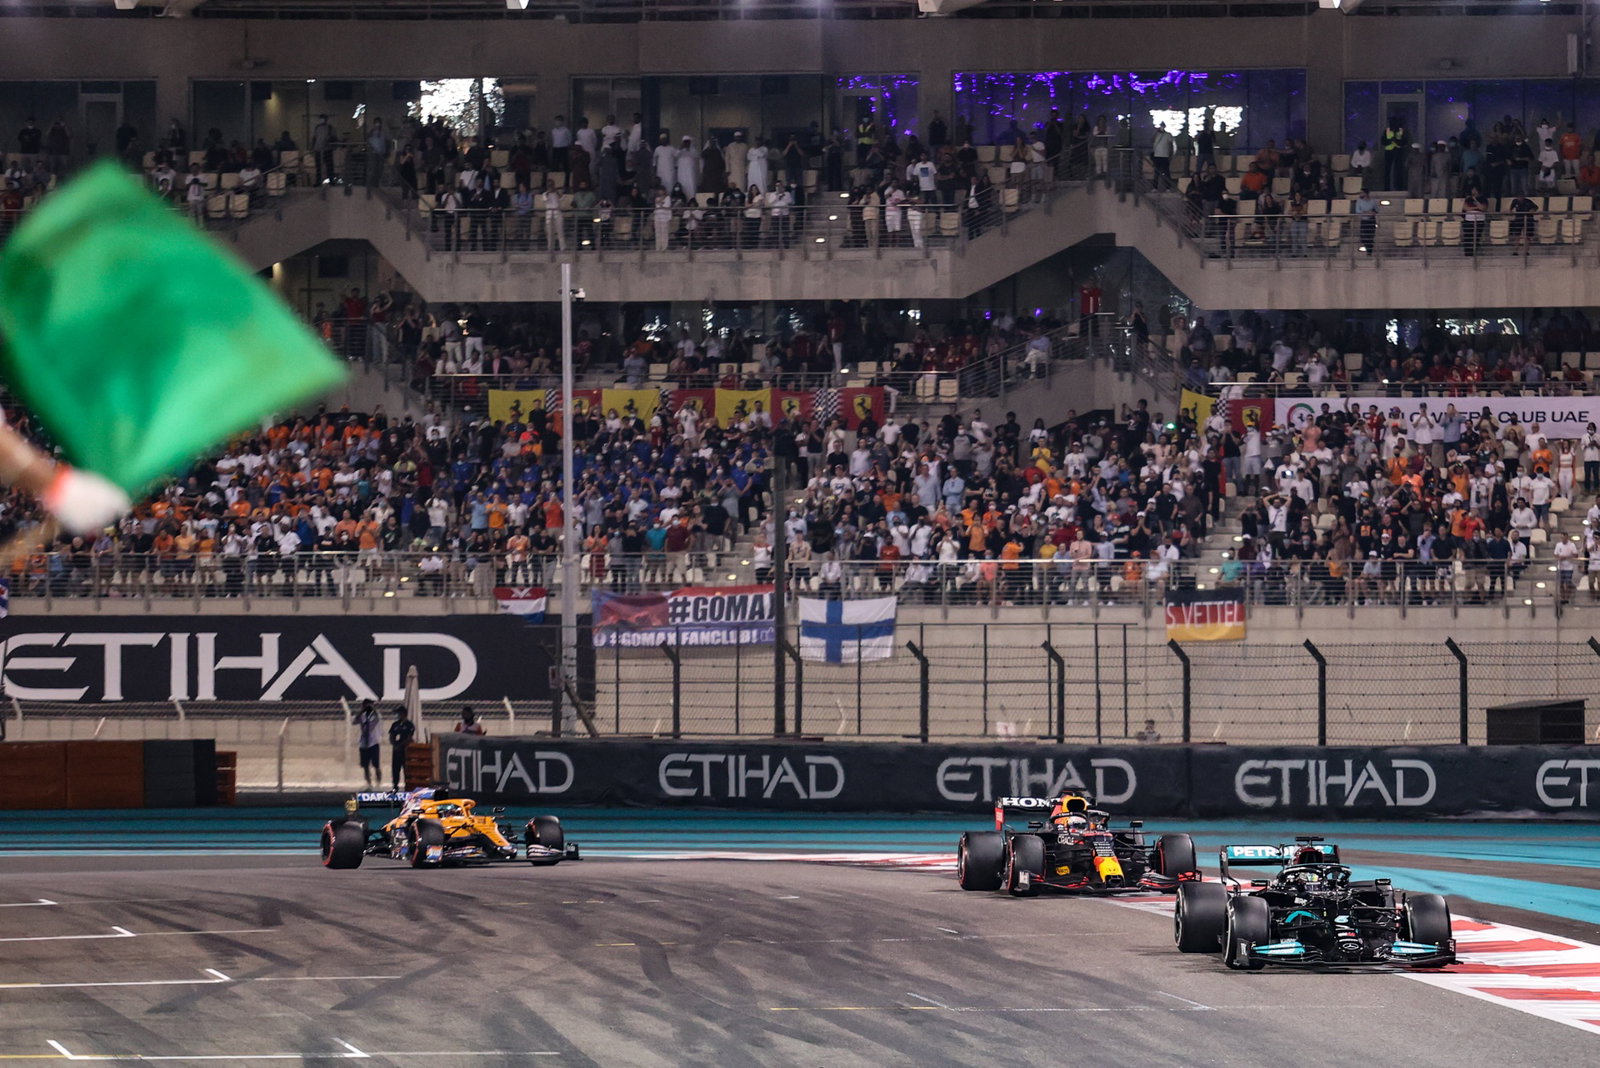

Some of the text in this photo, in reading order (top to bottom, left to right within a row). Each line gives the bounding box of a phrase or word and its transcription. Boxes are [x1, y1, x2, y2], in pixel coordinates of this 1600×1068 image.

[1551, 411, 1590, 422] UAE
[1181, 600, 1244, 628] VETTEL
[0, 632, 478, 700] ETIHAD
[446, 747, 574, 794] ETIHAD
[658, 753, 845, 799] ETIHAD
[936, 757, 1137, 804] ETIHAD
[1234, 759, 1436, 808] ETIHAD
